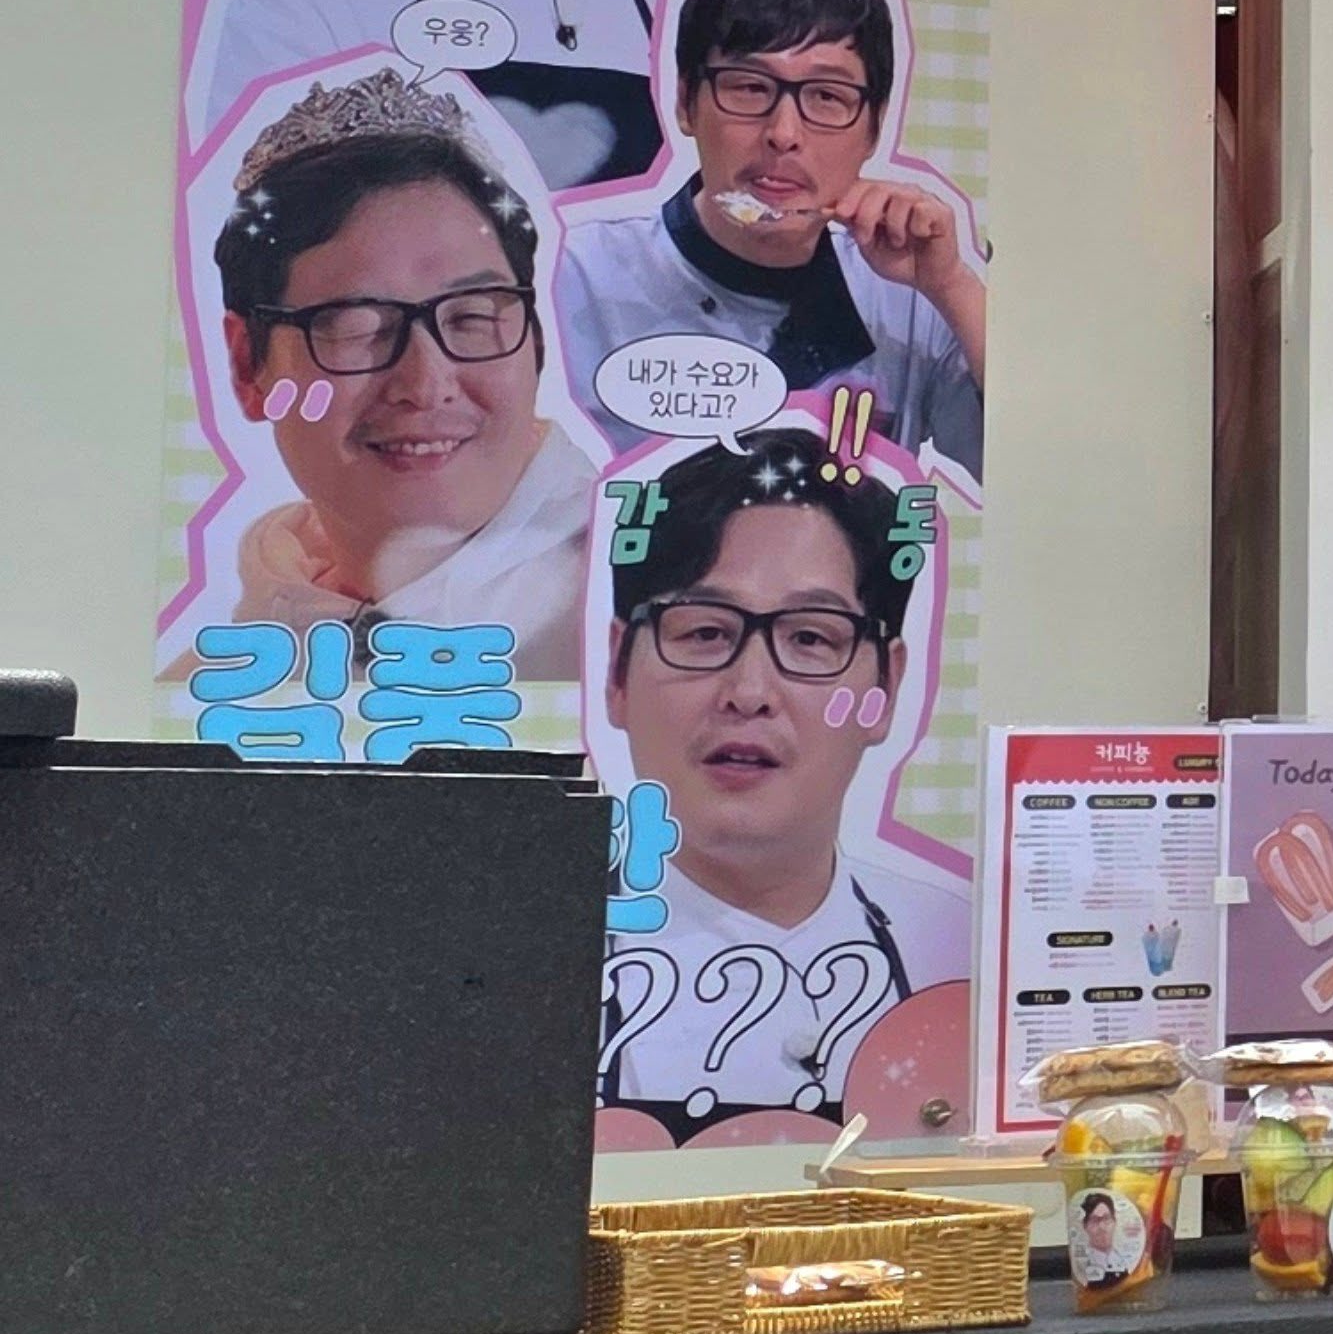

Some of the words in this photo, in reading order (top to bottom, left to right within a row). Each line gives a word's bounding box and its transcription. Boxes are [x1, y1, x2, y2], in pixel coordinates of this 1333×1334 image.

[421, 13, 490, 49] 우웅?
[628, 358, 677, 386] 내가
[686, 361, 759, 388] 수요가
[649, 391, 737, 419] 있다고?
[604, 479, 670, 566] 감
[888, 485, 937, 582] 동
[189, 621, 522, 762] 김풍
[1033, 992, 1054, 1004] TEA
[1117, 989, 1136, 1000] TEA
